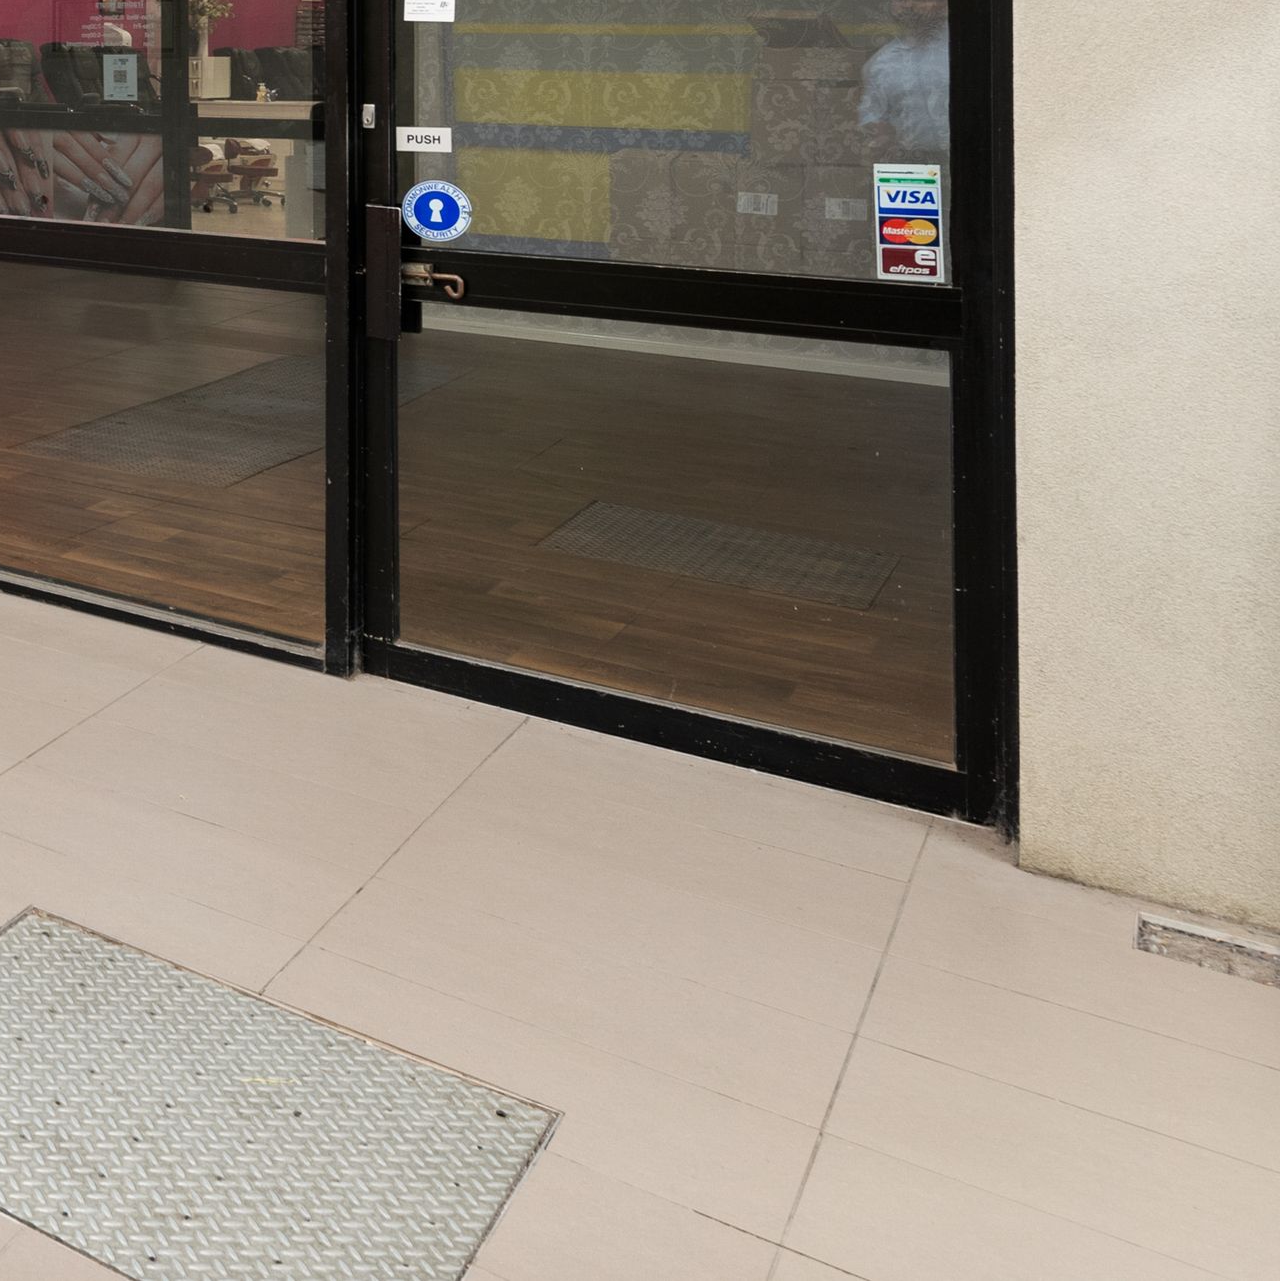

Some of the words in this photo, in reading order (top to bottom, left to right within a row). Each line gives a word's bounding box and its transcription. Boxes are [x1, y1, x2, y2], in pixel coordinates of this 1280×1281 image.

[406, 134, 441, 145] PUSH
[405, 183, 462, 219] COMMONWEALTH
[886, 189, 936, 205] VISA
[414, 223, 459, 238] SECURITY
[882, 226, 936, 237] MasterCard
[889, 264, 931, 275] eftpos
